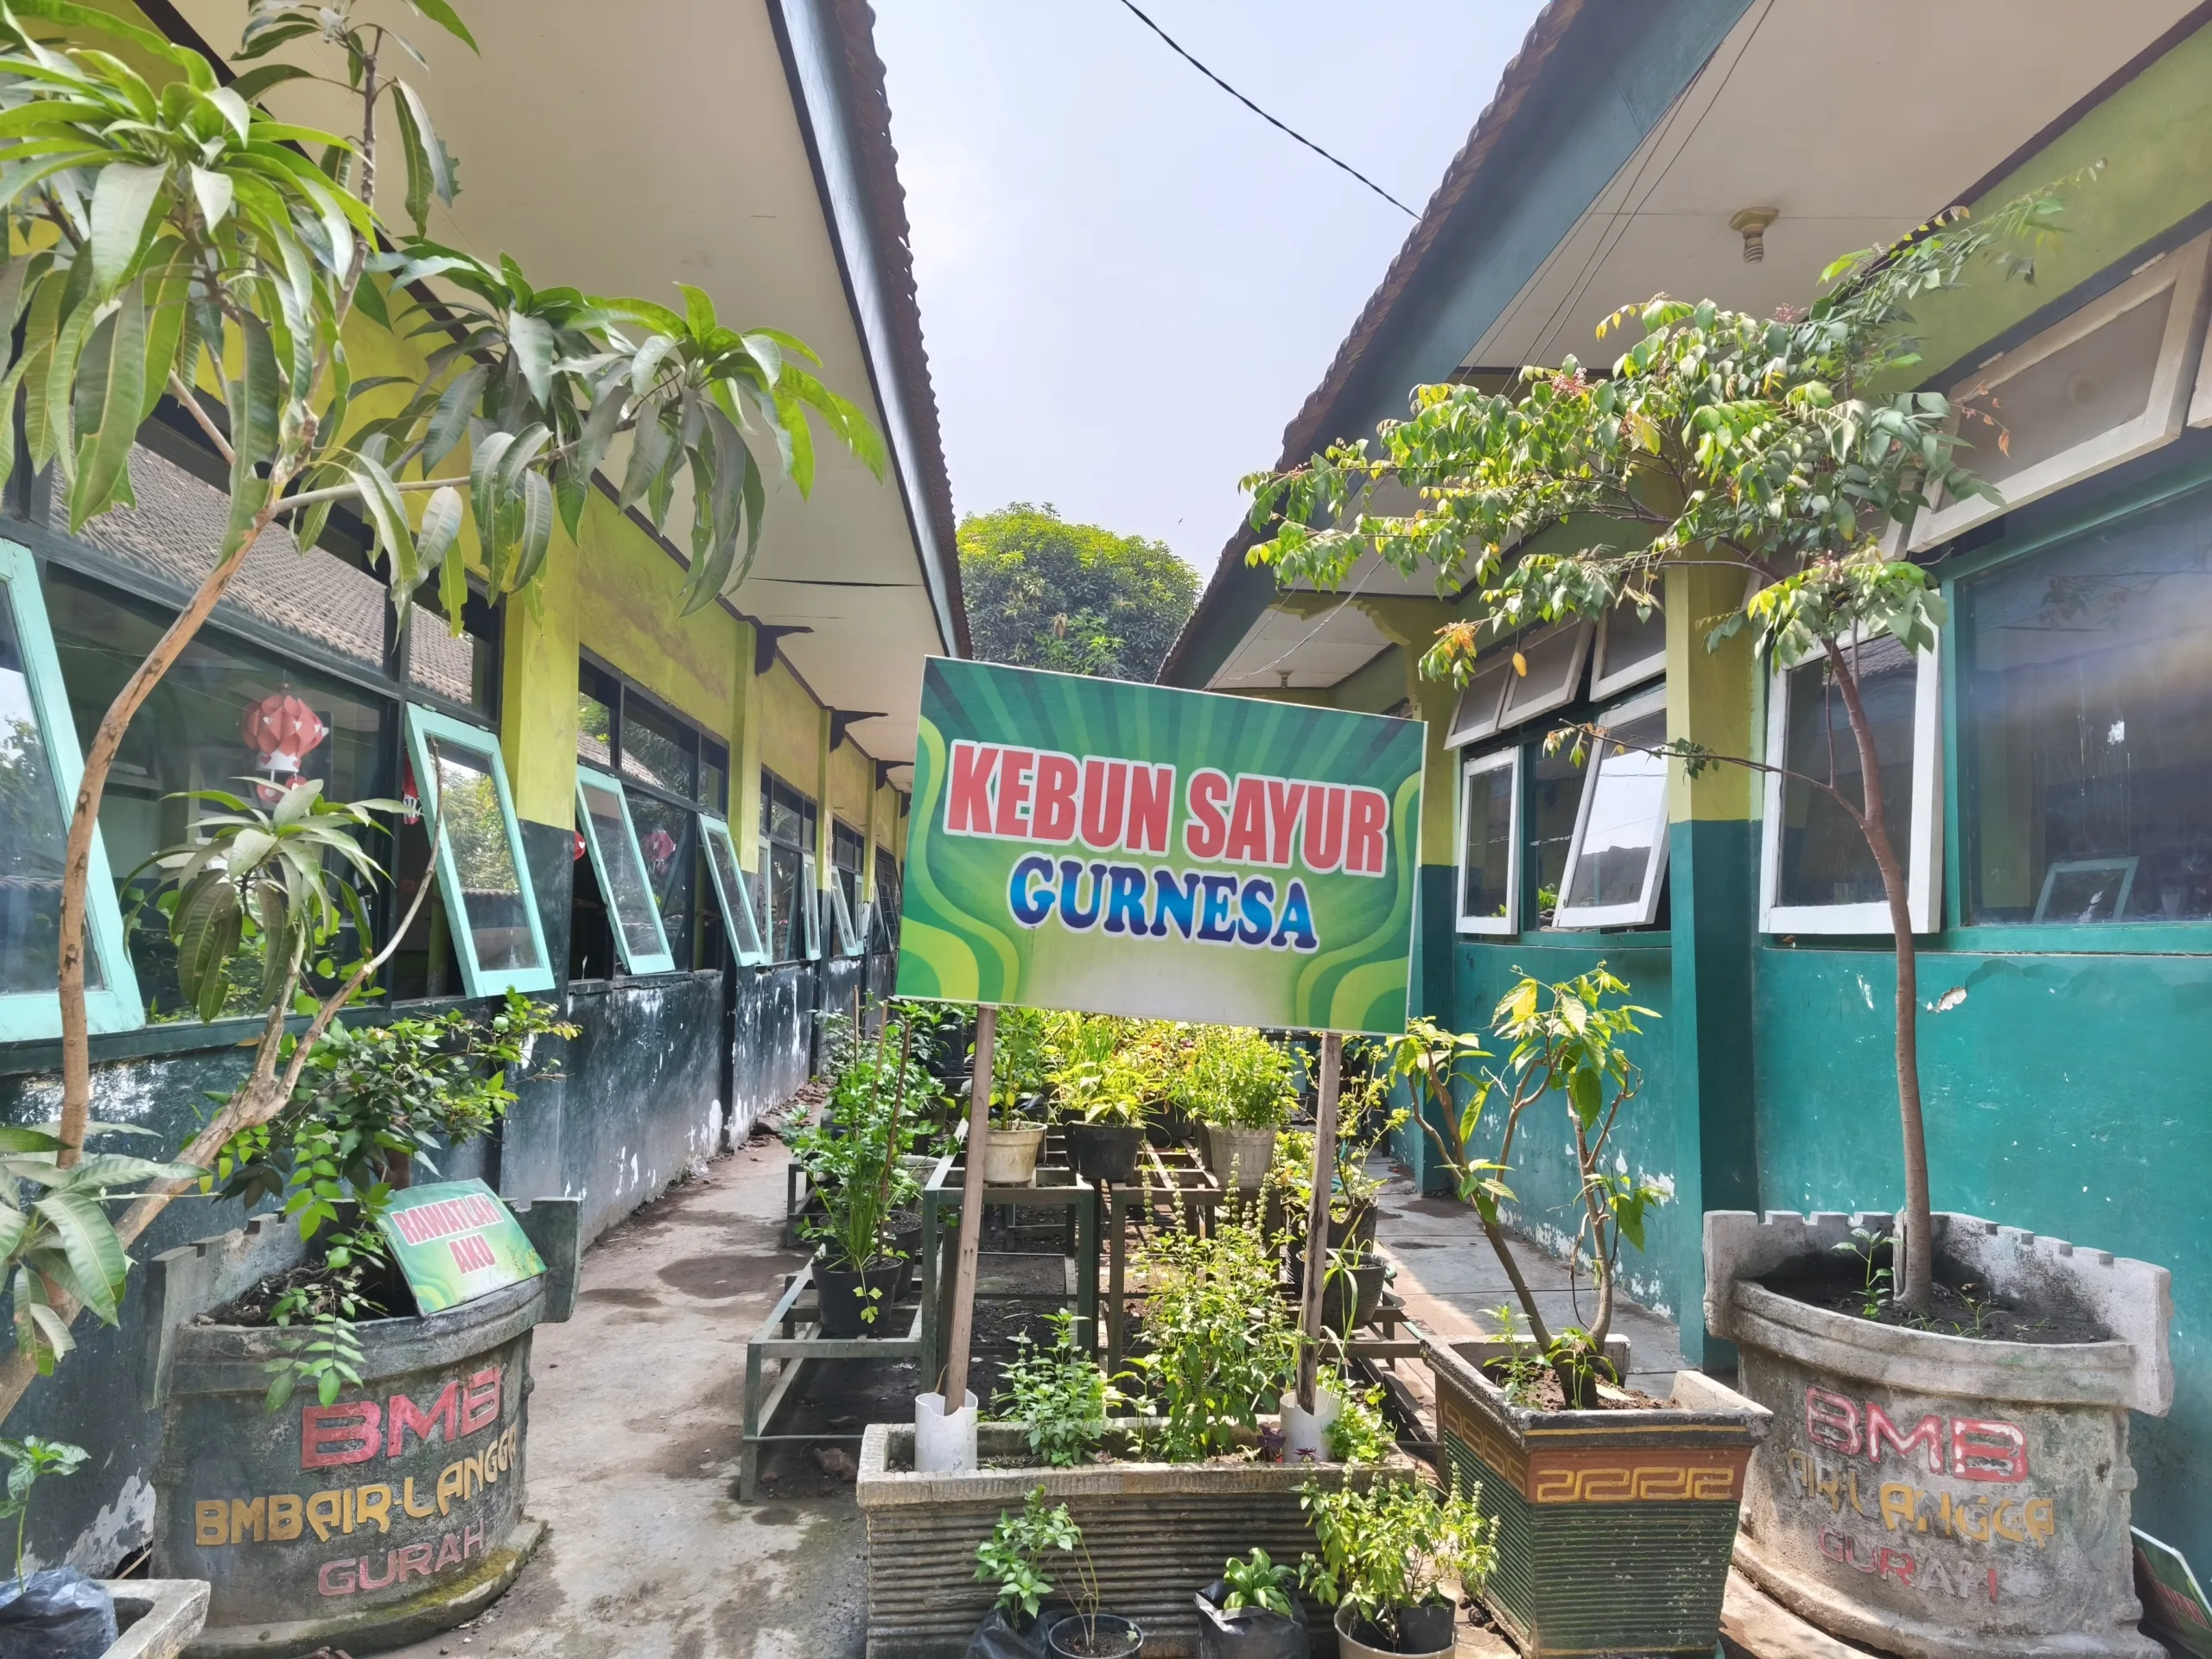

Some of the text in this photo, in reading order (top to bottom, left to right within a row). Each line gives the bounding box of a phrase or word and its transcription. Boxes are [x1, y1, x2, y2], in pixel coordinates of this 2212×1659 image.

[944, 741, 1390, 878] KEBUN SAYUR
[1007, 851, 1320, 954] GURNESA
[390, 1192, 504, 1246] RAWATLAH
[447, 1233, 497, 1274] AKU
[301, 1365, 503, 1469] BMB
[1805, 1384, 2028, 1483] BMB
[317, 1521, 485, 1597] GURAH
